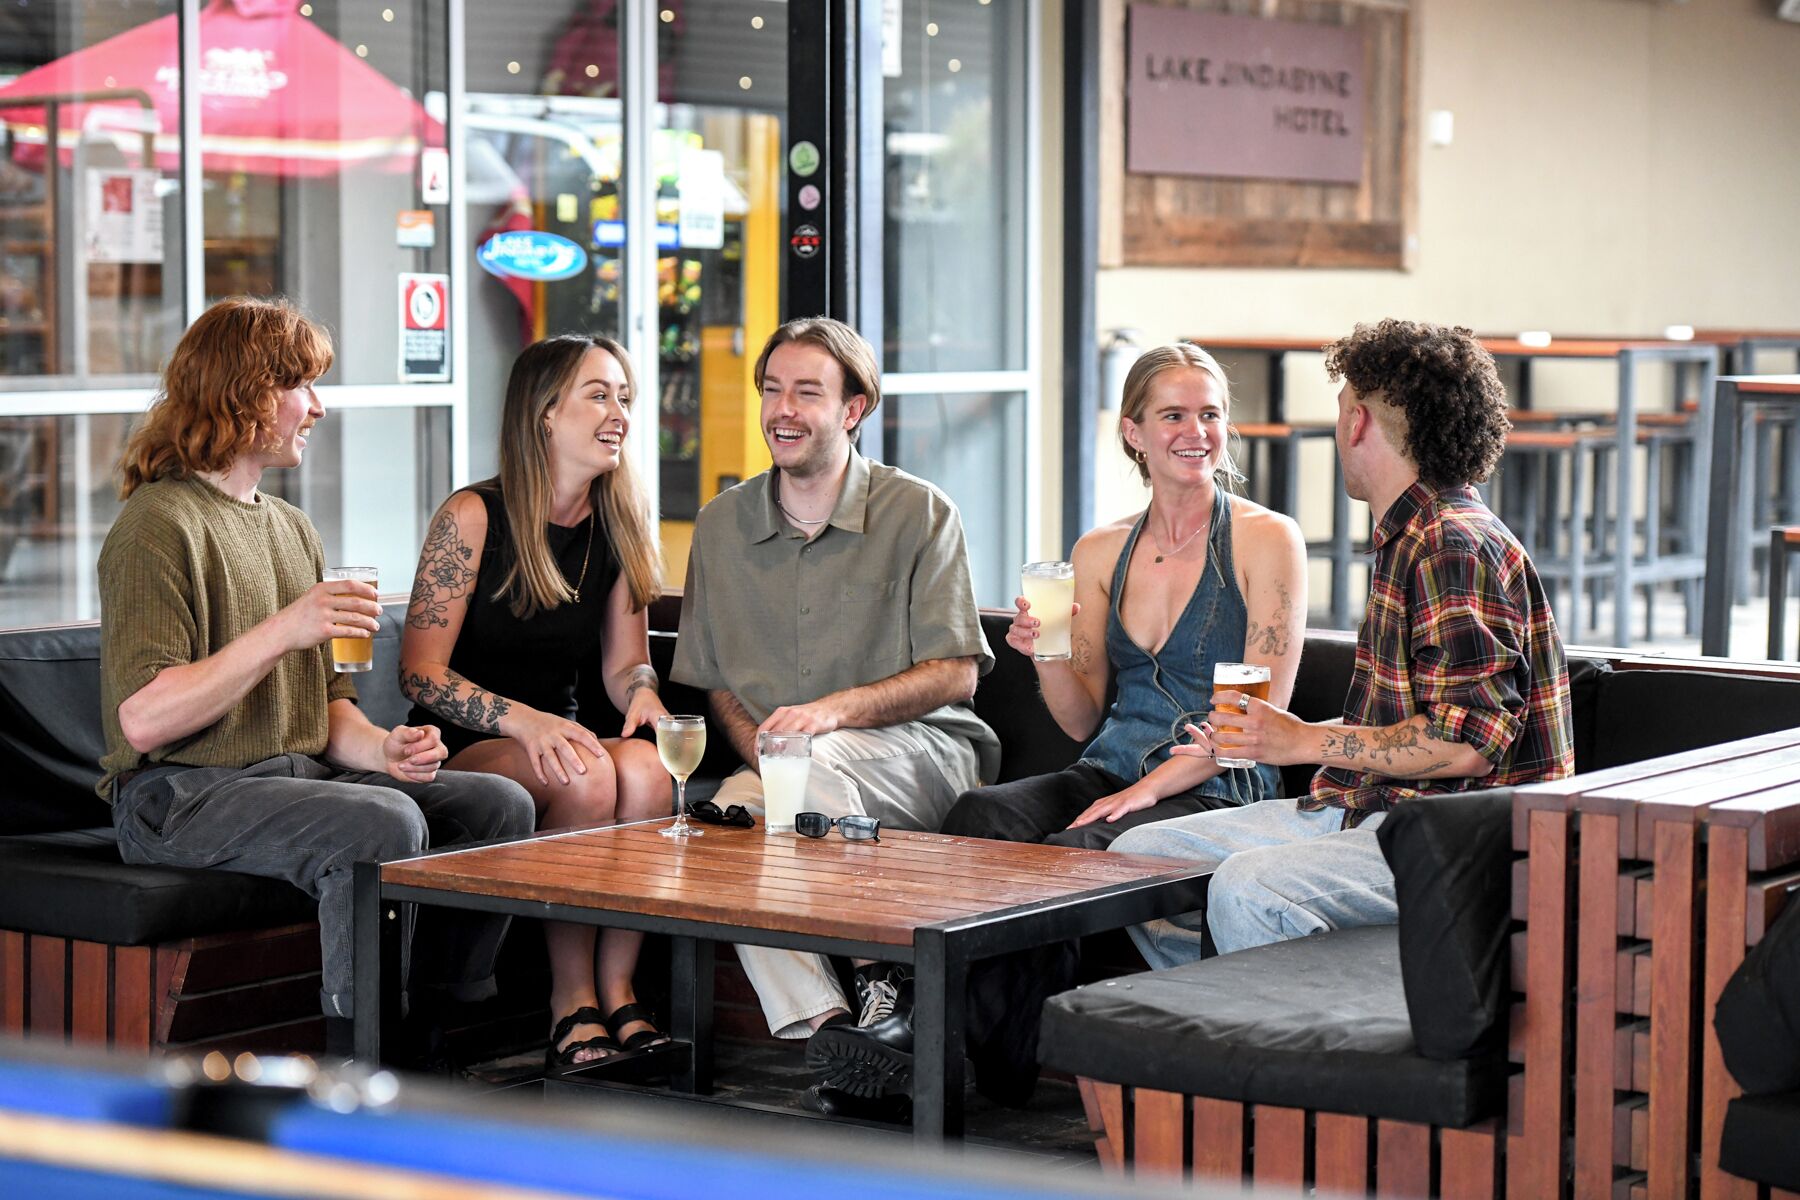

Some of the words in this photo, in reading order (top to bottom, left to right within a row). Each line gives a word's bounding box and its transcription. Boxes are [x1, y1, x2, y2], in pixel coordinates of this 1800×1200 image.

[1146, 54, 1211, 86] LAKE
[1219, 60, 1351, 99] JINDABYNE
[1274, 104, 1350, 137] HOTEL
